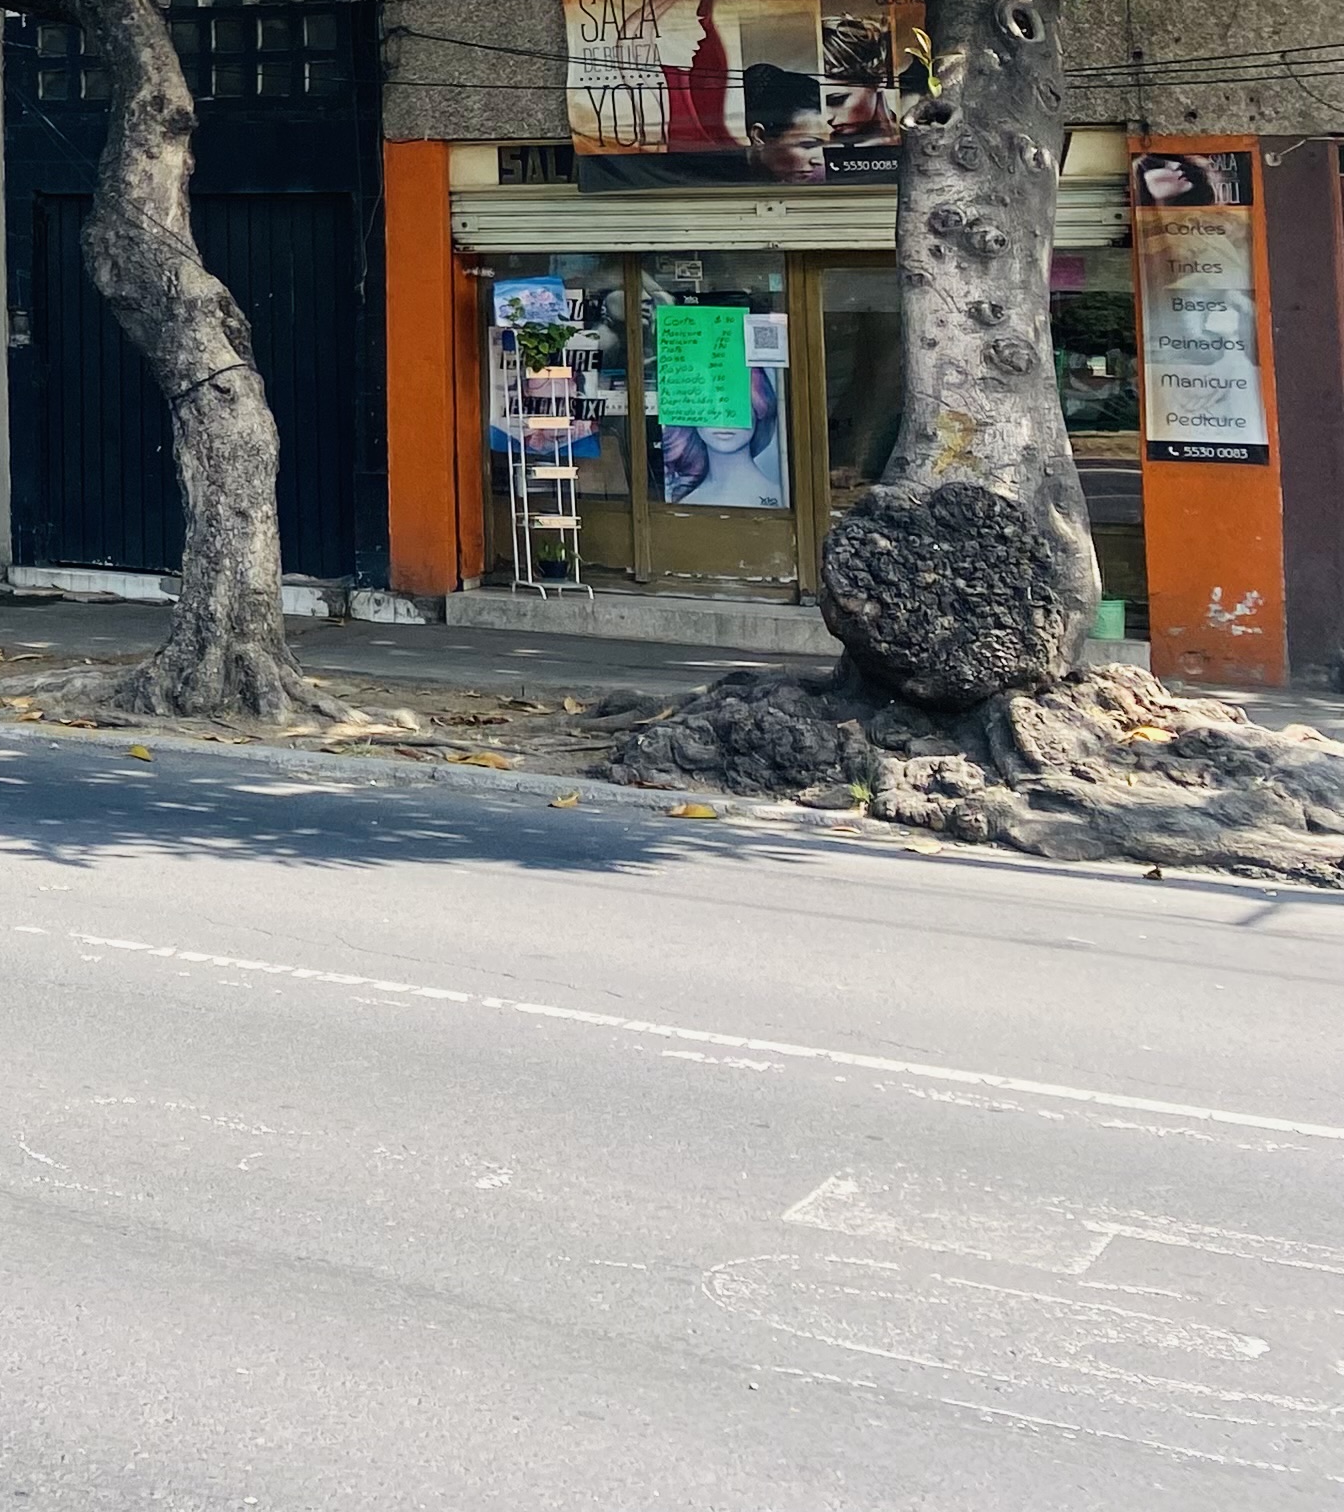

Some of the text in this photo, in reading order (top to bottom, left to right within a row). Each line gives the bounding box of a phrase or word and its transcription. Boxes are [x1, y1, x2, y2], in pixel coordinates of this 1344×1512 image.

[499, 146, 578, 184] SAL
[843, 160, 870, 171] 5530
[1165, 221, 1227, 236] Cortes
[1168, 259, 1224, 274] Tintes
[1172, 297, 1228, 313] Bases
[1159, 336, 1246, 351] Peinados
[1161, 374, 1248, 389] Manicure
[1166, 412, 1247, 429] Pedicure
[1183, 446, 1249, 459] 5530 0083
